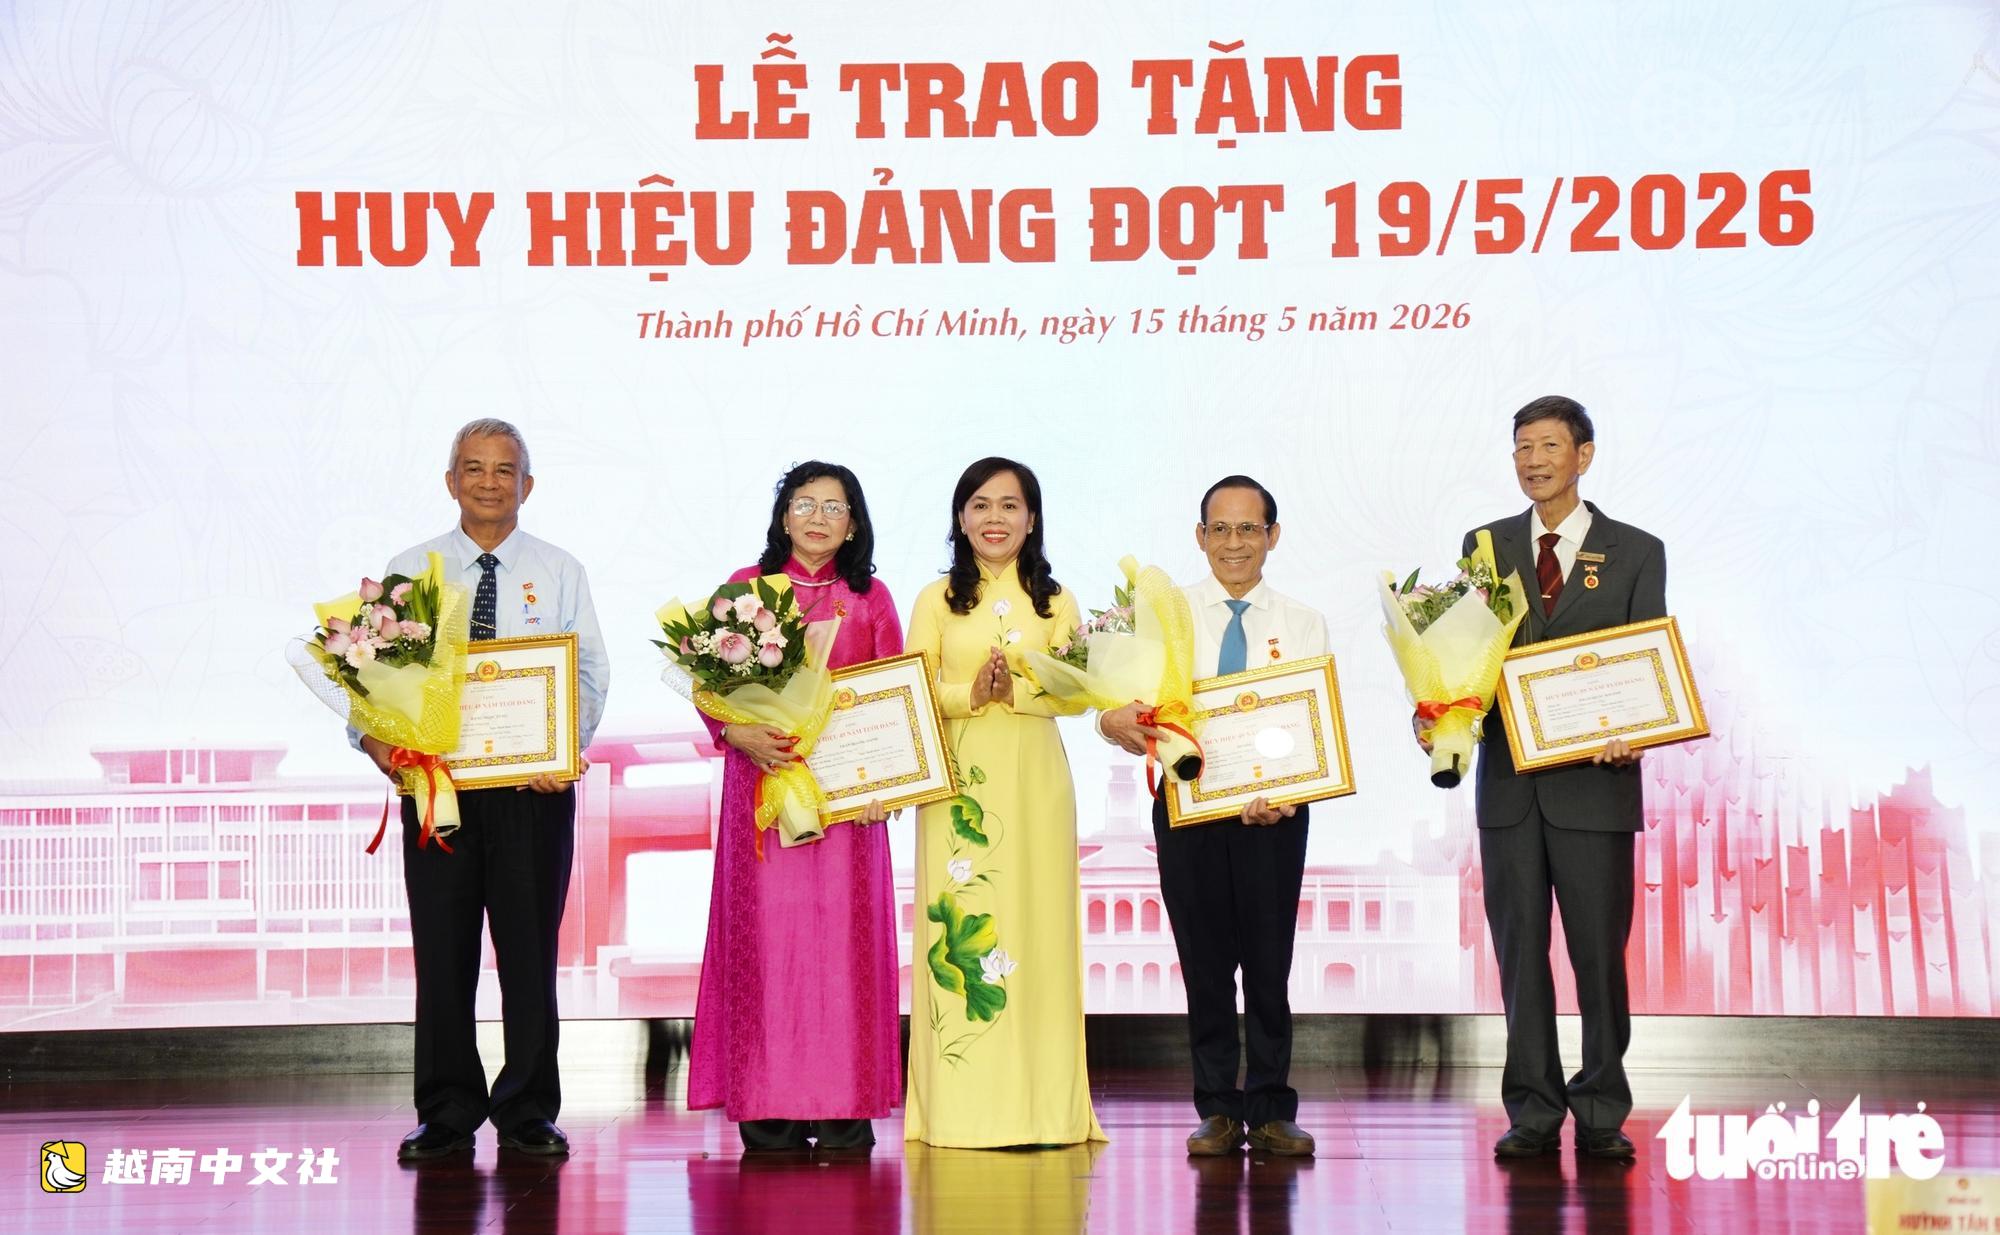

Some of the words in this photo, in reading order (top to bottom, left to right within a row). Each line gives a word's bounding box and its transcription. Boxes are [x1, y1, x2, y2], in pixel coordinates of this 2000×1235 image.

[694, 33, 810, 139] LỄ
[839, 61, 1099, 139] TRAO
[1131, 40, 1403, 149] TẶNG
[295, 191, 495, 267] HUY
[526, 174, 755, 282] HIỆU
[785, 167, 1056, 265] ĐẢNG
[1088, 184, 1285, 276] ĐỢT
[1325, 169, 1814, 258] 19/5/2026
[636, 310, 732, 340] Thành
[743, 304, 812, 347] phố
[815, 304, 861, 338] Hồ
[871, 305, 927, 337] Chí
[937, 308, 1028, 342] Minh,
[1040, 311, 1116, 345] ngày
[1130, 307, 1165, 335] 15
[1177, 303, 1266, 341] tháng
[1278, 304, 1298, 332] 5
[1308, 306, 1378, 333] năm
[1389, 302, 1472, 331] 2026
